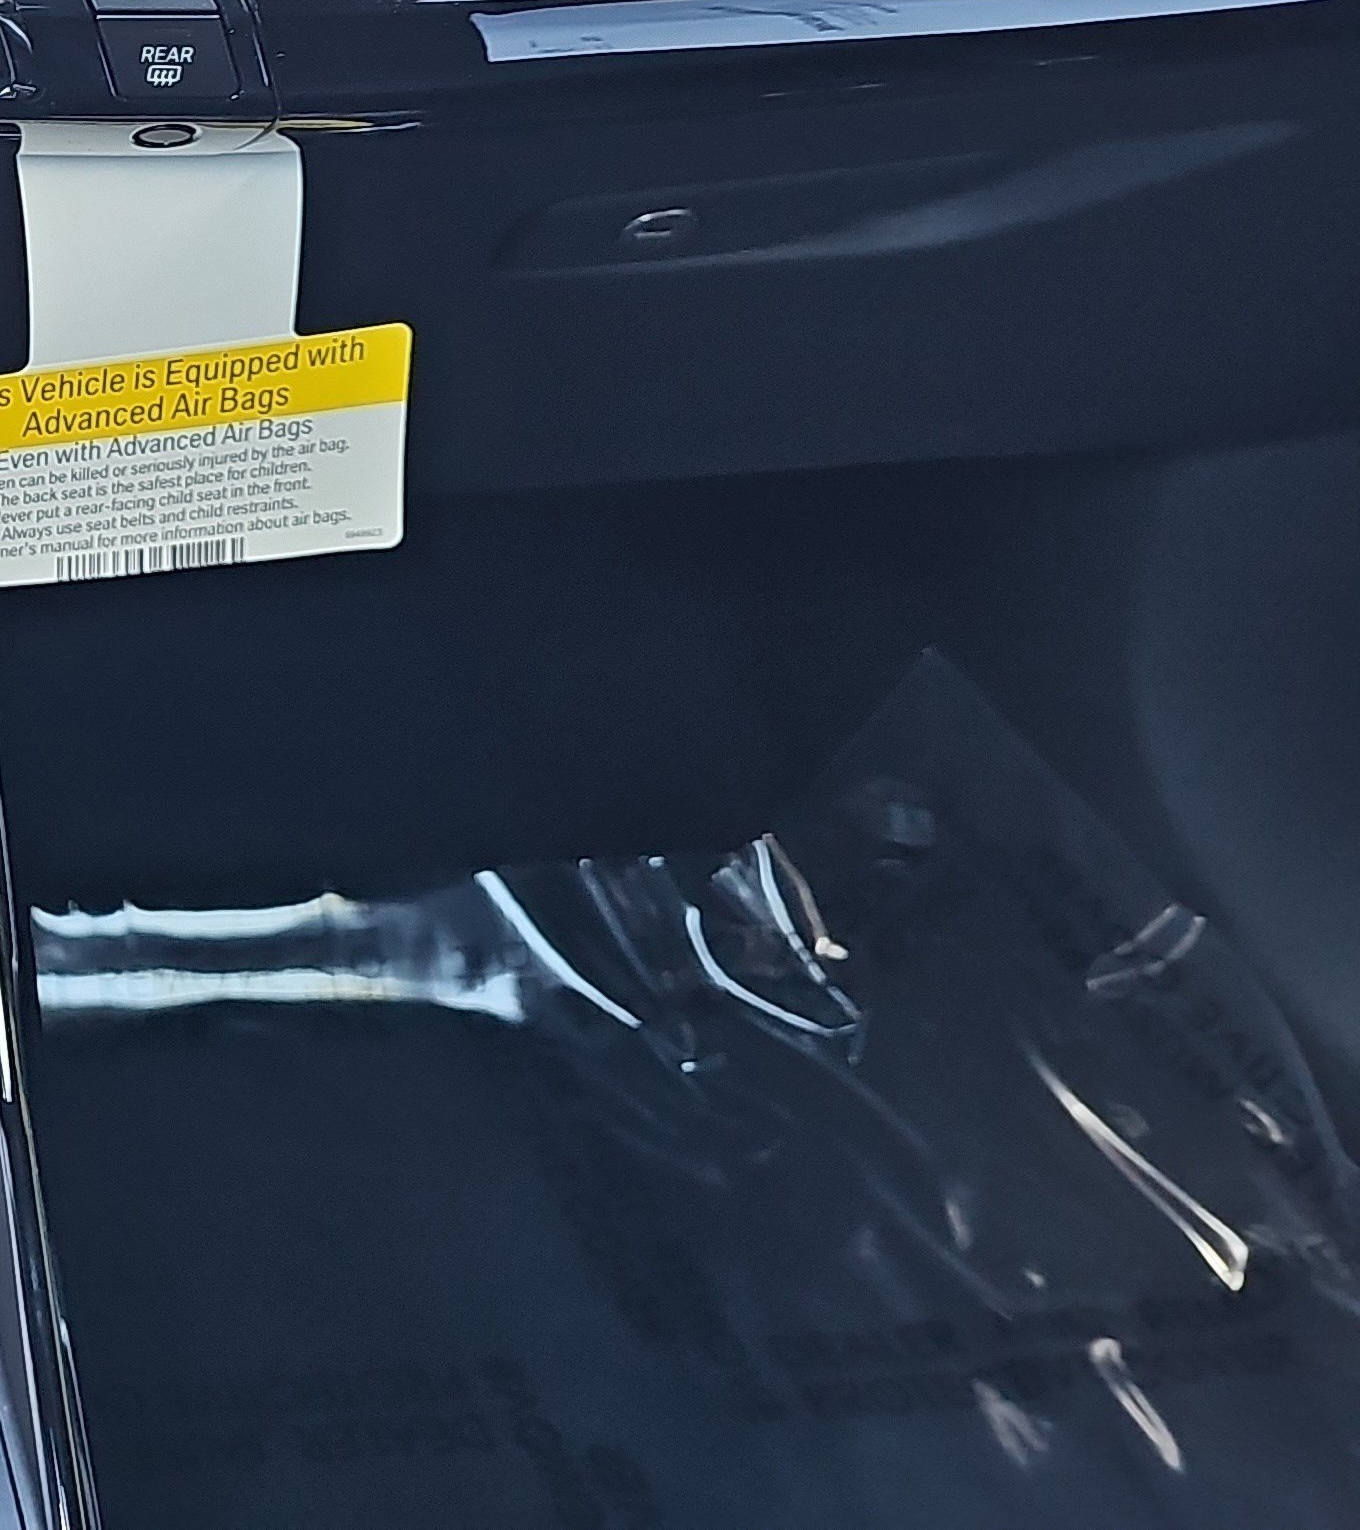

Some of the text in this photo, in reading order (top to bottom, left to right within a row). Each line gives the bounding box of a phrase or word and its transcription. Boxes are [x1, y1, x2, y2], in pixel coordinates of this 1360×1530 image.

[140, 46, 194, 63] REAR
[21, 368, 125, 403] Vehicle
[134, 364, 155, 390] is
[166, 344, 300, 388] Equipped
[308, 336, 364, 367] with
[22, 387, 290, 437] Advanced Air Bags
[19, 474, 46, 488] can
[49, 470, 67, 485] be
[71, 467, 109, 481] killed
[112, 464, 126, 476] or
[130, 455, 195, 475] seriously
[198, 448, 247, 468] injured
[251, 447, 268, 462] by
[272, 444, 295, 458] the
[298, 441, 316, 455] air
[319, 438, 350, 454] bag.
[55, 441, 101, 464] with
[107, 426, 216, 458] Advanced
[221, 422, 254, 444] Air
[258, 419, 313, 441] Bags
[23, 489, 58, 504] back
[61, 484, 93, 500] seat
[96, 483, 108, 496] is
[112, 480, 135, 495] the
[137, 474, 182, 491] safest
[185, 471, 223, 489] place
[227, 467, 247, 482] for
[250, 460, 312, 479] children.
[36, 505, 60, 523] put
[64, 505, 72, 517] a
[75, 495, 156, 516] rear-facing
[159, 490, 193, 506] child
[196, 486, 228, 502] seat
[231, 484, 244, 499] in
[247, 480, 272, 496] the
[273, 476, 311, 493] front.
[1, 497, 298, 541] Always use seat belts and child restraints.
[40, 535, 94, 555] manual
[97, 532, 116, 548] for
[120, 530, 158, 546] more
[161, 520, 244, 541] information
[247, 515, 289, 531] about
[291, 512, 310, 526] air
[312, 507, 352, 525] bags.
